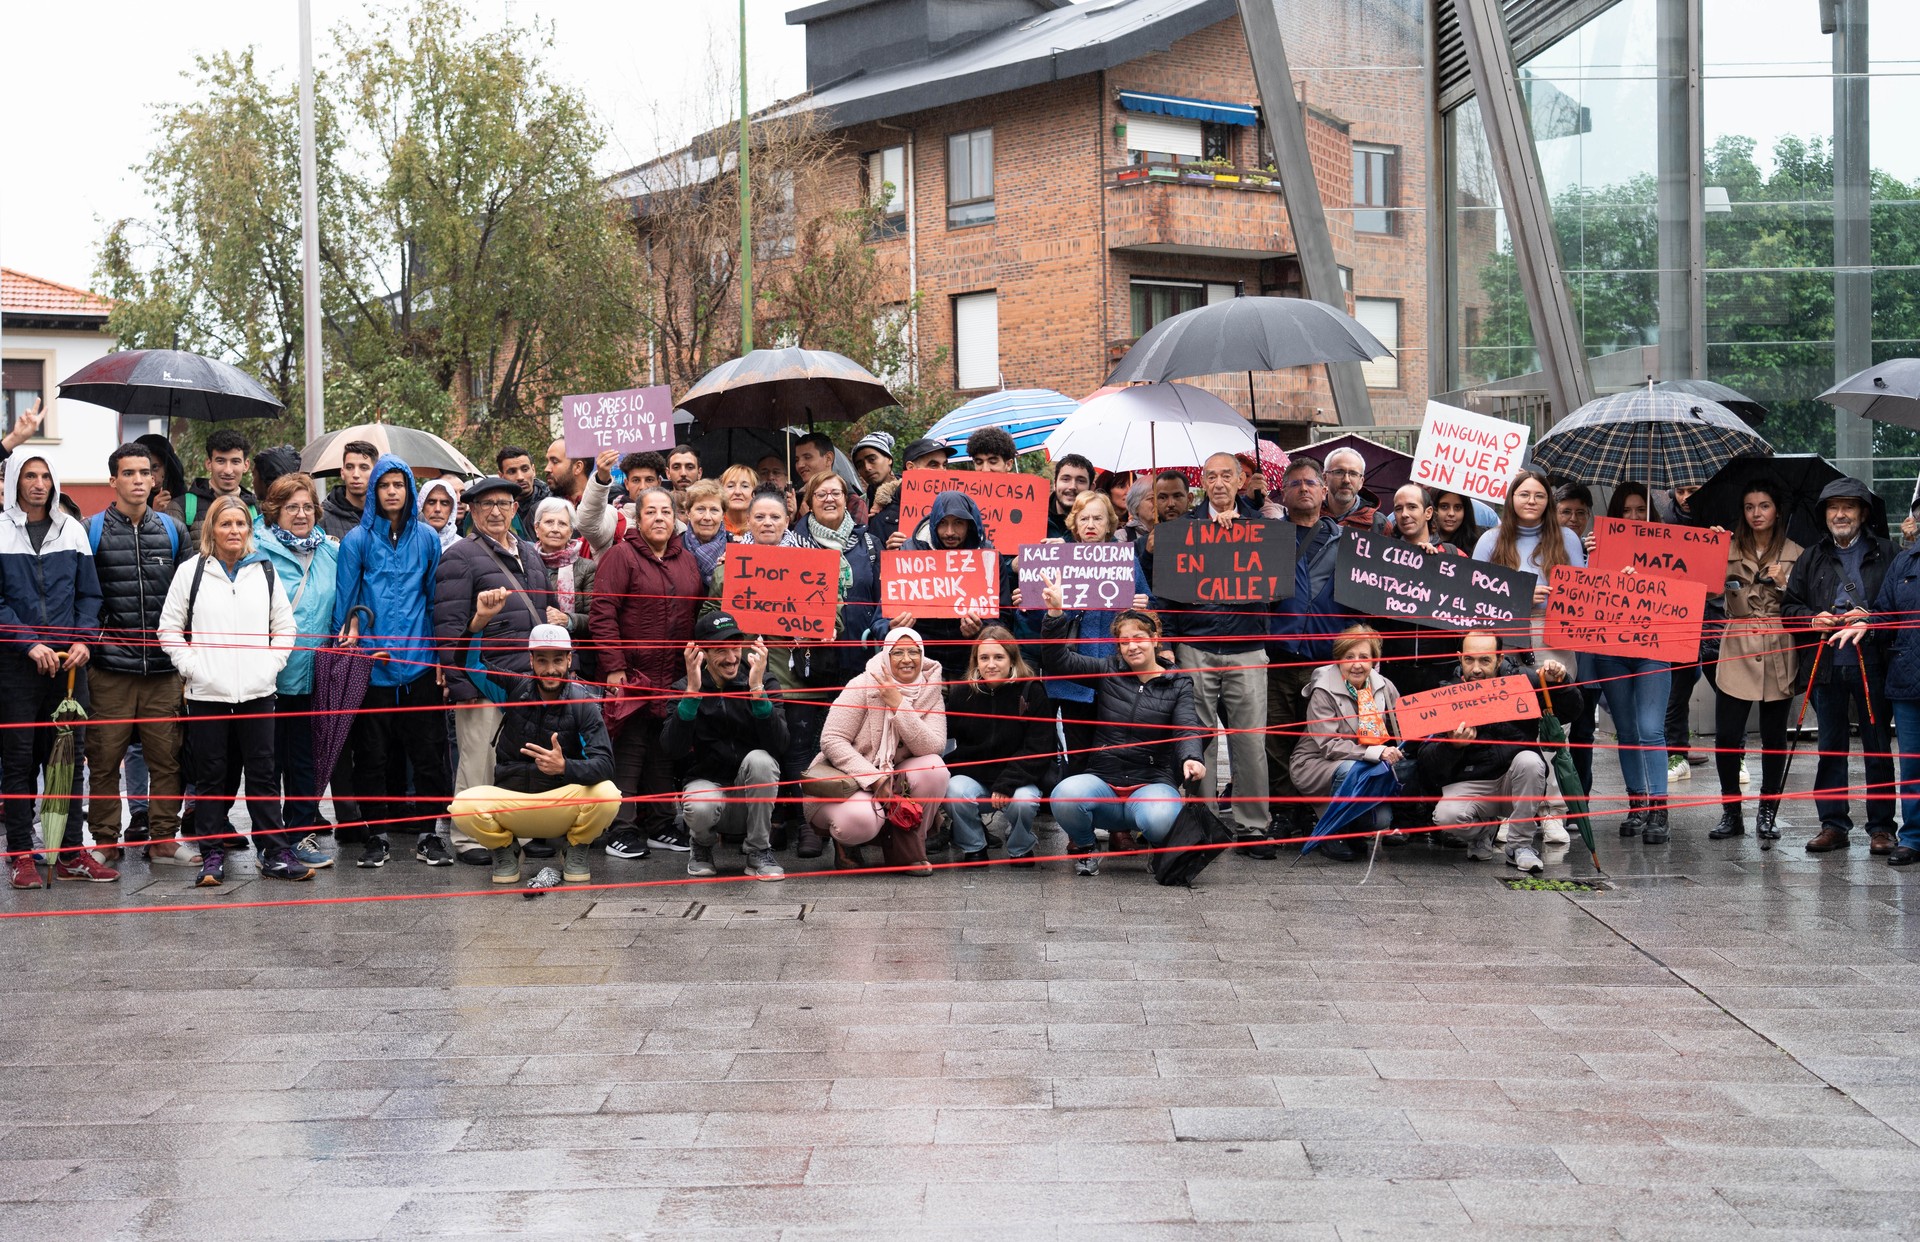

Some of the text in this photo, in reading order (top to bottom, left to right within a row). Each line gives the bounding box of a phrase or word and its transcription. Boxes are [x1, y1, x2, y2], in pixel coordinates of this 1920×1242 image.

[573, 394, 644, 418] NO SABES LO
[578, 411, 655, 430] QUE ES SI NO
[593, 430, 612, 447] TE
[1431, 420, 1498, 451] NINGUNA
[1434, 442, 1510, 475] MUJER
[906, 480, 920, 492] NI
[996, 484, 1035, 502] CASA
[1417, 459, 1508, 500] SIN HOGA
[902, 503, 918, 518] NI
[1608, 521, 1720, 545] NO TENER CASA
[895, 556, 937, 574] INOR
[1024, 545, 1135, 562] KALE EGOERAN
[1176, 551, 1263, 574] EN LA
[1633, 552, 1688, 573] MATA
[734, 556, 827, 586] Inor ez
[1062, 565, 1134, 582] EMAKUMERIK
[1382, 546, 1424, 570] CIELO
[1439, 561, 1457, 578] ES
[1471, 570, 1511, 597] POCA
[1554, 568, 1667, 597] NO TENER HOGAR
[732, 586, 797, 613] etxerik
[887, 575, 967, 601] ETXERIK
[1061, 583, 1090, 608] EZ
[953, 595, 999, 616] GABE
[1386, 597, 1418, 614] POCO
[1439, 593, 1449, 607] Y
[1452, 597, 1467, 611] EL
[1474, 602, 1514, 622] SUELO
[1556, 584, 1688, 619] SIGNIFICA MUCHO
[777, 616, 825, 633] gabe
[1594, 610, 1624, 625] QUE
[1628, 614, 1652, 629] NO
[1560, 621, 1659, 649] TENER CASA
[1401, 678, 1507, 706] LA VIVIENDA ES
[1420, 690, 1509, 720] UN DERECHO
